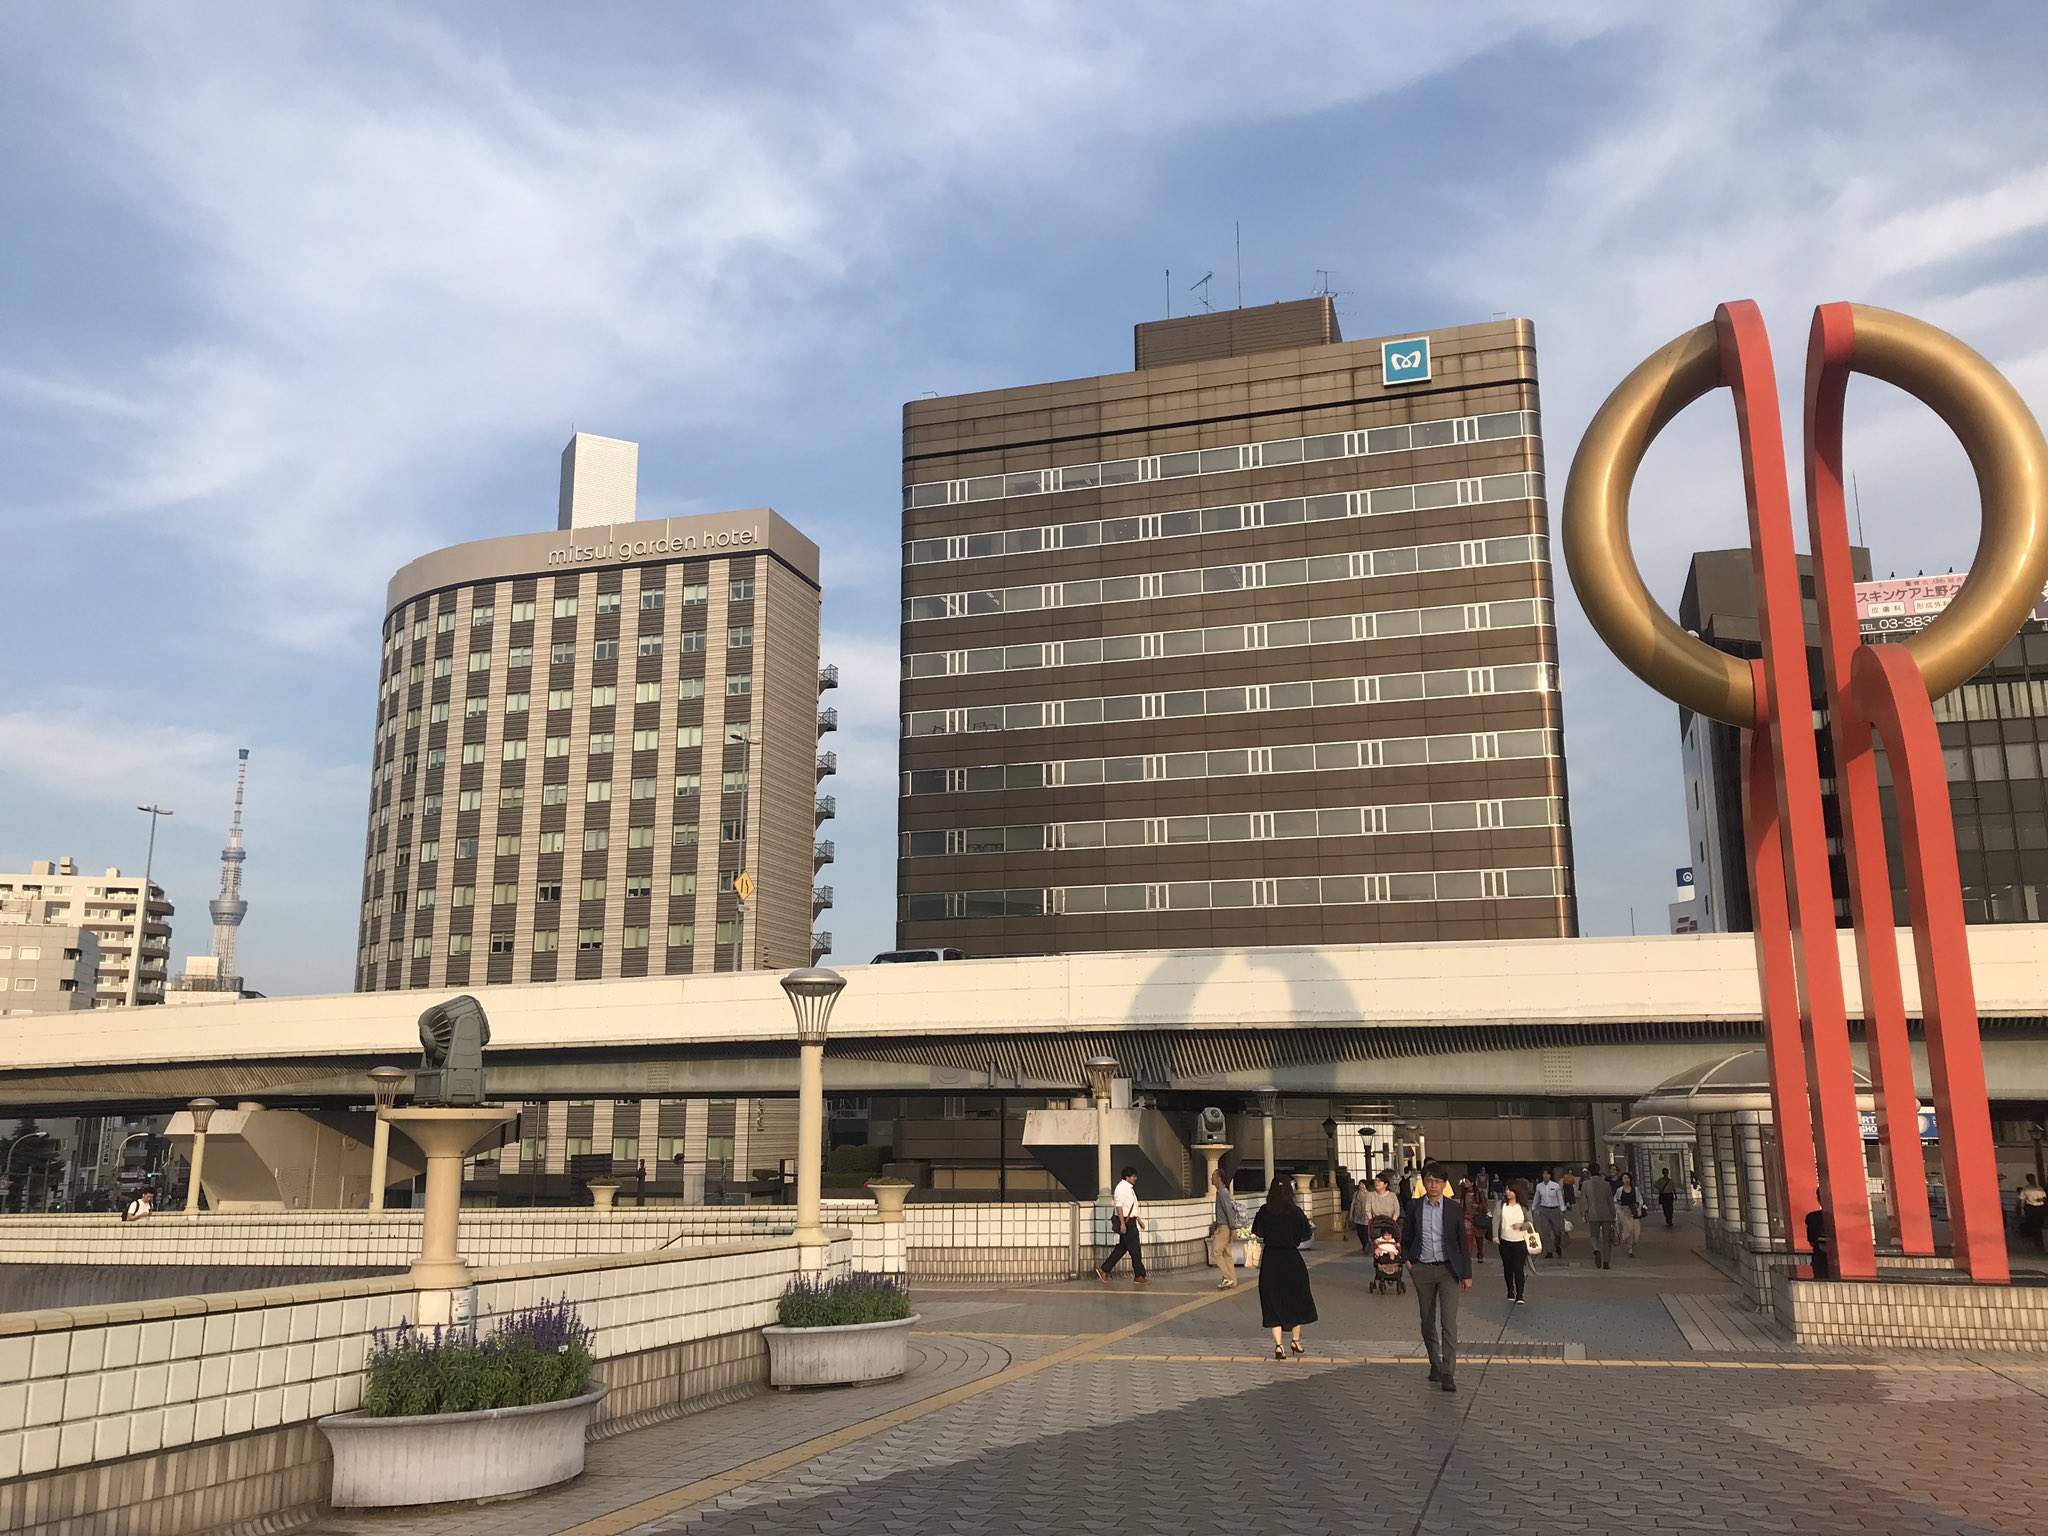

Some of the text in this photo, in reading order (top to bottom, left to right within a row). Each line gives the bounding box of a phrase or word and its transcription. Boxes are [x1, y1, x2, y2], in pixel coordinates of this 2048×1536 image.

[548, 517, 759, 564] mitsui garden hotel
